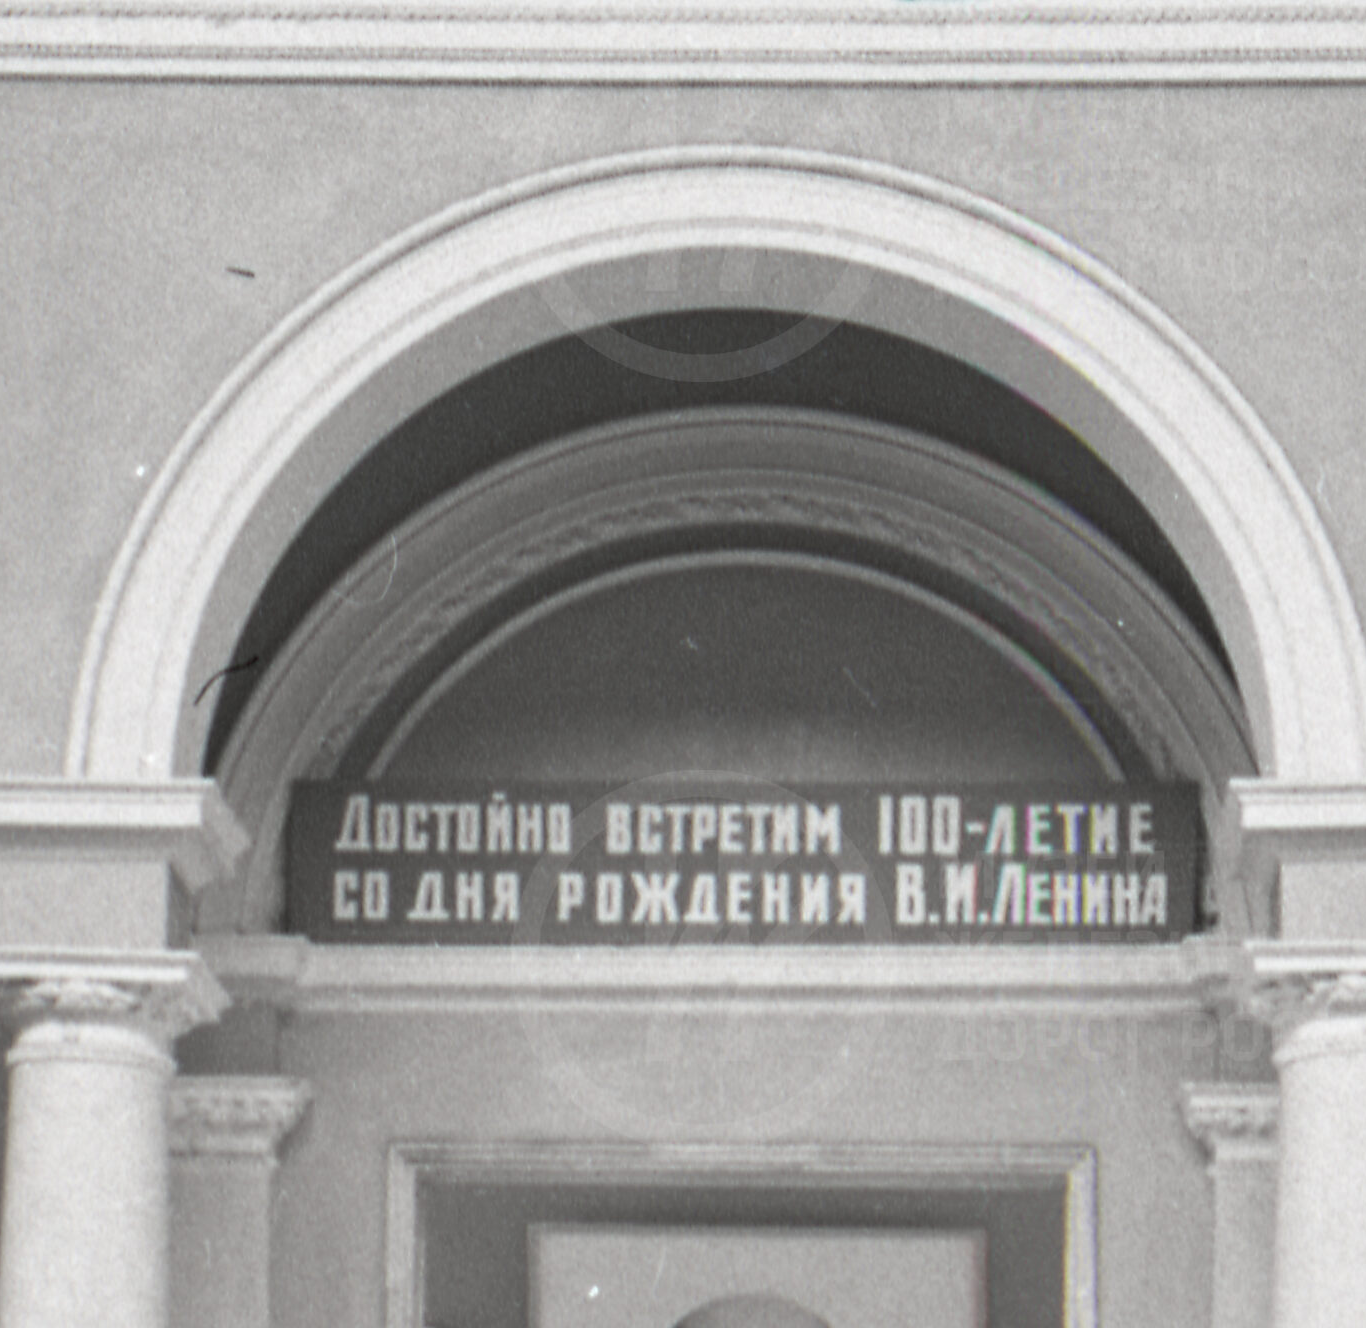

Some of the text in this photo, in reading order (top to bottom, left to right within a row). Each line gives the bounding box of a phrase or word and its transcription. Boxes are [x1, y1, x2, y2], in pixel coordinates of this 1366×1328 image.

[878, 794, 1154, 855] 100-ЛЕТИЕ
[334, 869, 390, 921] СО
[406, 870, 520, 922] ДНЯ
[556, 871, 867, 924] РОЖДЕНИЯ
